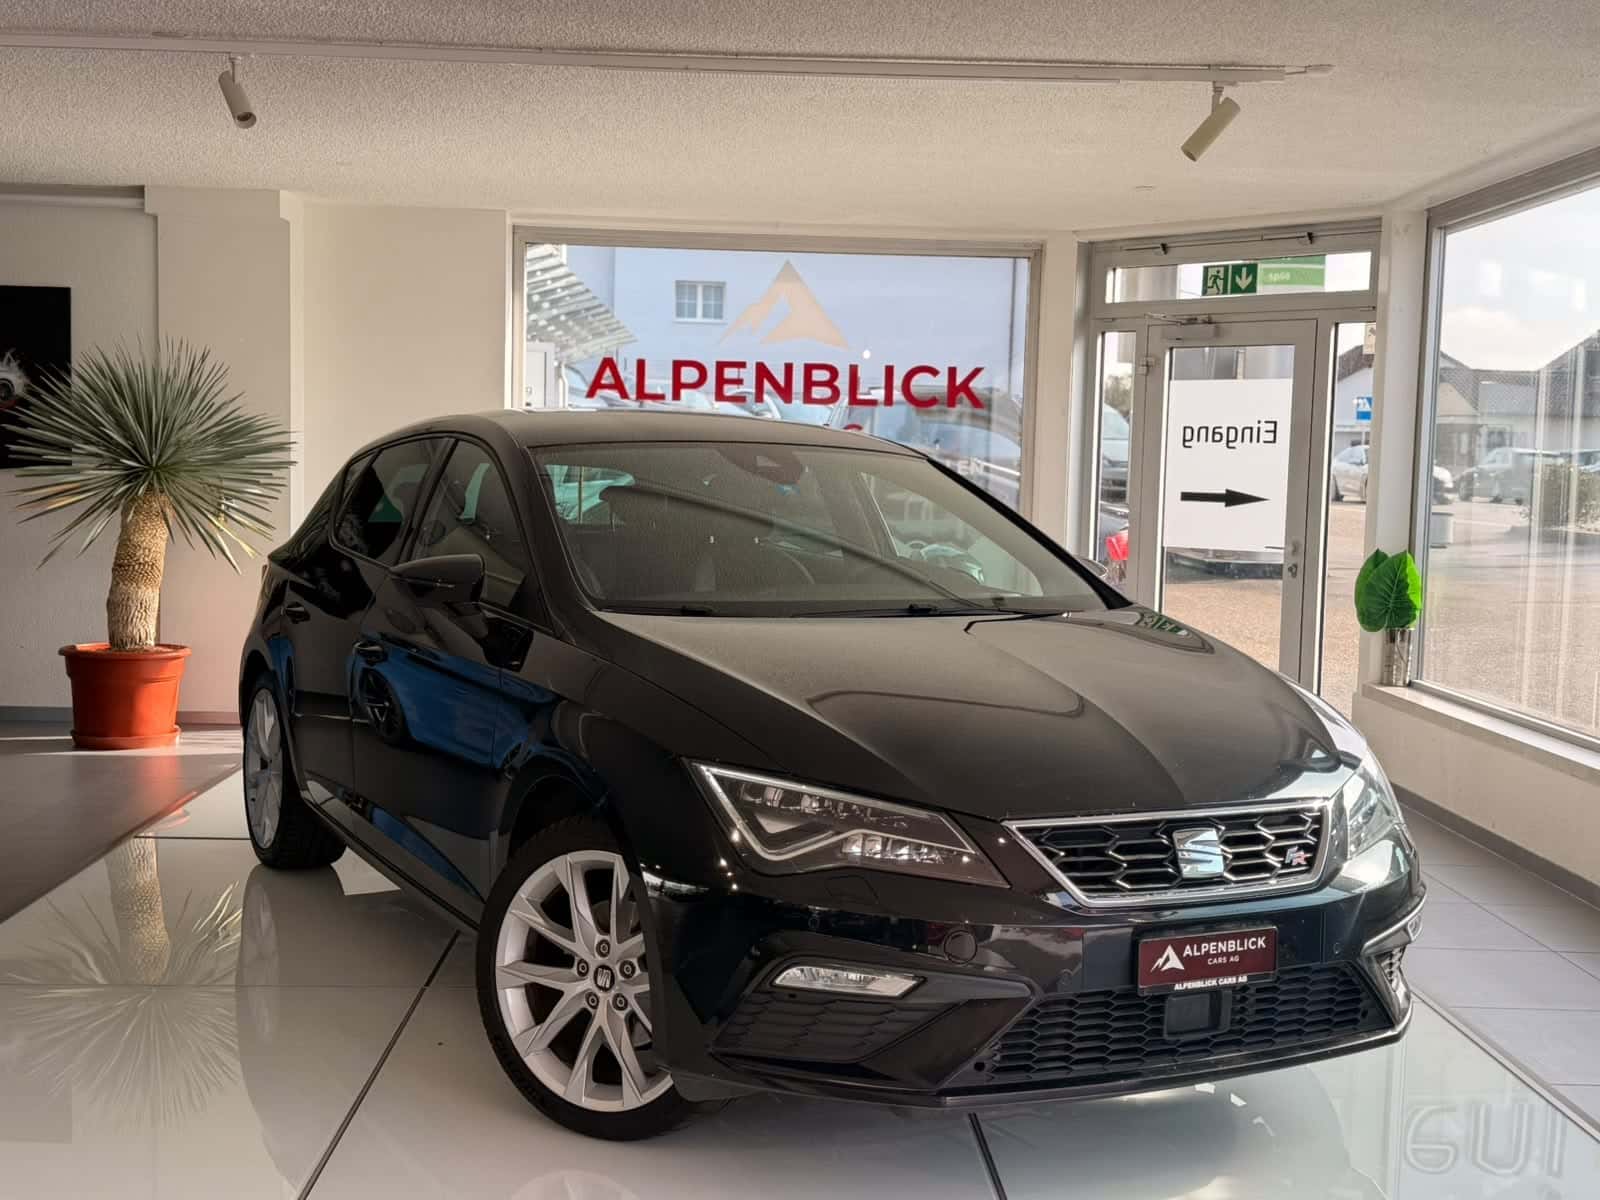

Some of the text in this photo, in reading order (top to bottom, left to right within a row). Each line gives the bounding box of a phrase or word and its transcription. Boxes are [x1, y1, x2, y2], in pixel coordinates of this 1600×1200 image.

[585, 355, 986, 409] ALPENBLICK
[1183, 936, 1266, 957] ALPENBLICK
[1207, 954, 1240, 965] CARS AG
[1174, 975, 1248, 990] ALPENBLICK CARS AG
